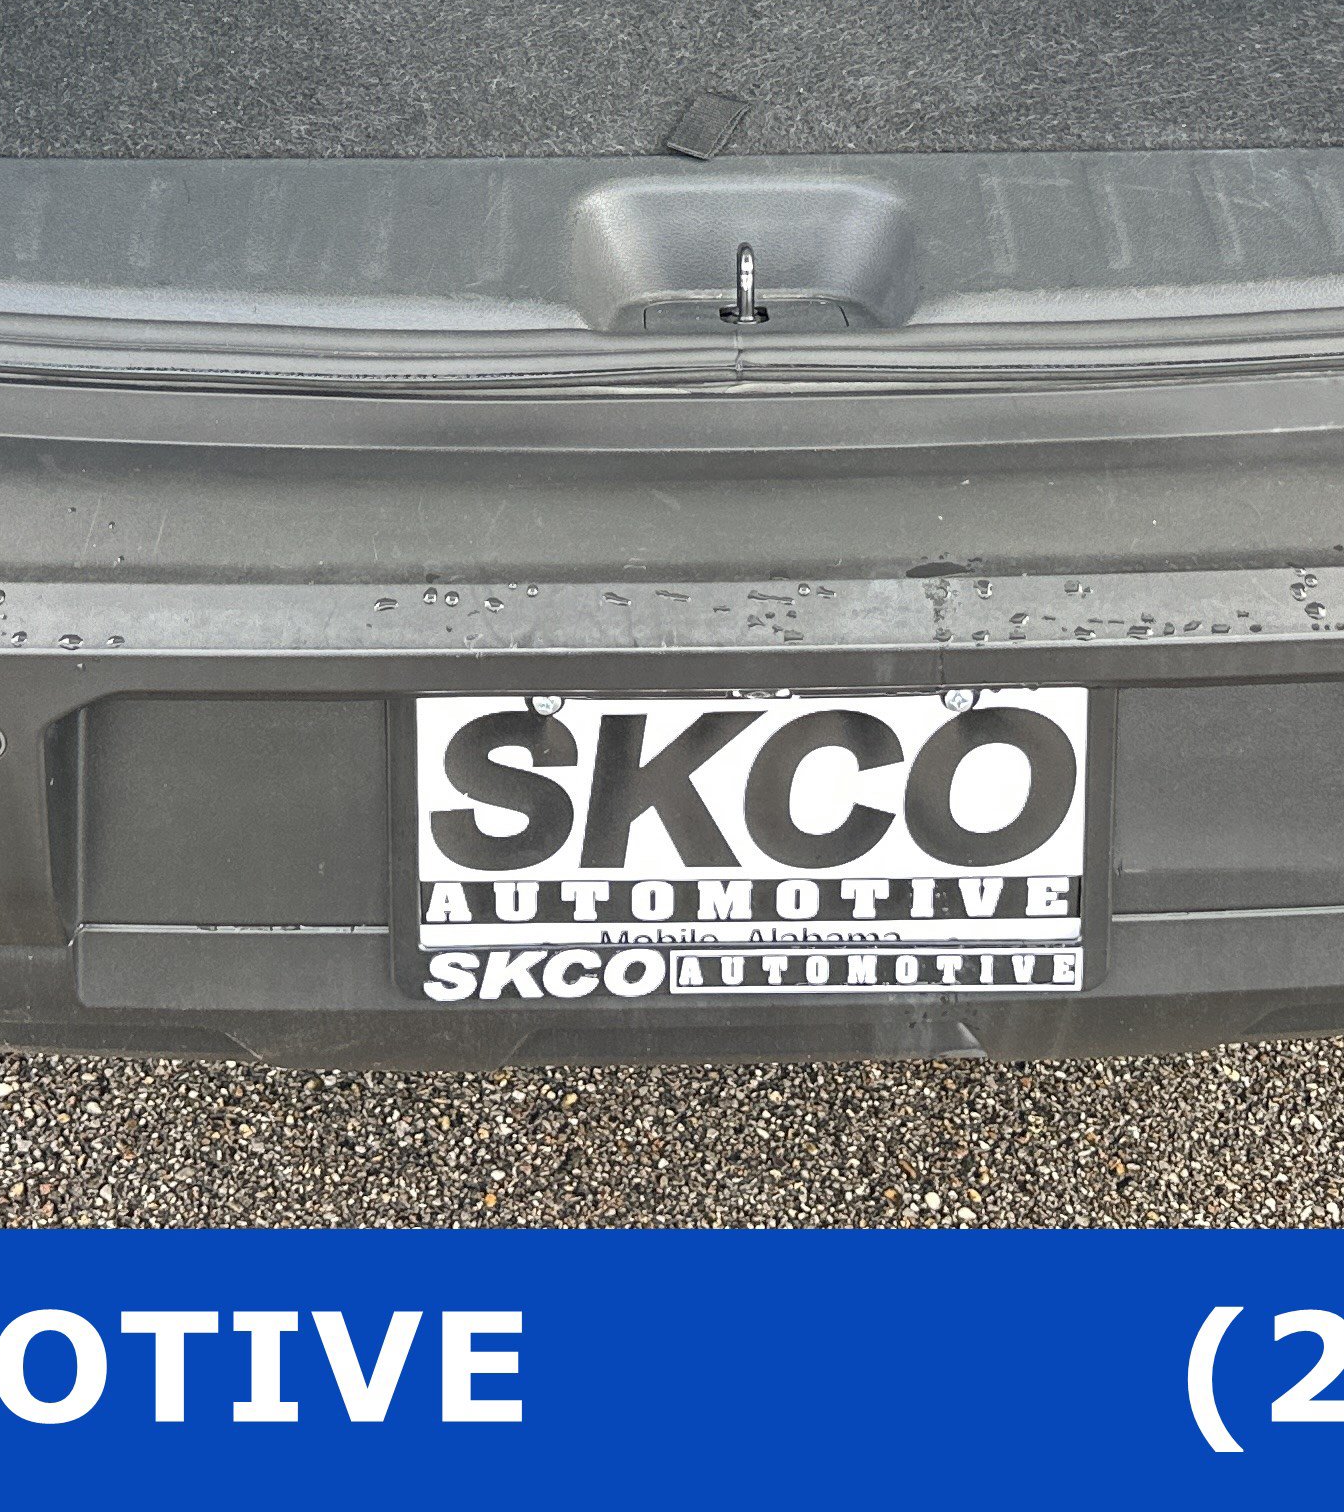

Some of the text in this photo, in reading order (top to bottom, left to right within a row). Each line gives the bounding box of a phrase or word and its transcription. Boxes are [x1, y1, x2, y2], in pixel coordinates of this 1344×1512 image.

[430, 707, 1077, 871] SKCO
[425, 876, 1070, 922] AUTOMOTIVE
[423, 949, 1076, 1002] SKCO AUTOMOTIVE
